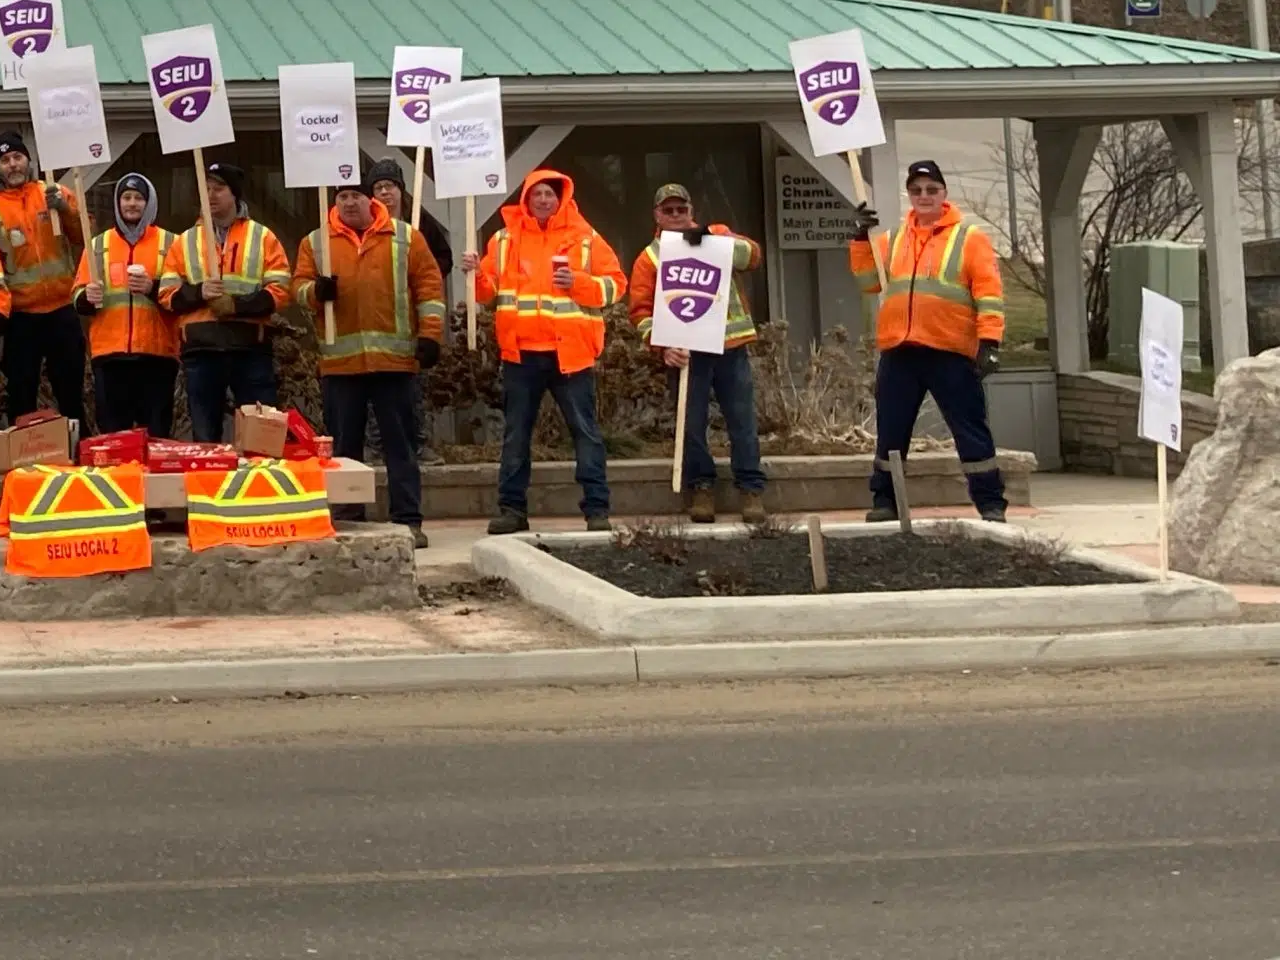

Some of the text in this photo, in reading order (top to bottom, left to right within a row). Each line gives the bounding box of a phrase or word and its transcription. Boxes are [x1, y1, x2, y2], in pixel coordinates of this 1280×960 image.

[5, 7, 48, 26] SEIU
[23, 37, 37, 54] 2
[160, 63, 204, 86] SEIU
[807, 67, 852, 91] SEIU
[181, 96, 197, 116] 2
[414, 102, 428, 118] 2
[830, 100, 846, 120] 2
[301, 114, 338, 125] Locked
[310, 132, 330, 142] Out
[782, 219, 813, 228] Main
[784, 232, 800, 241] on
[666, 266, 715, 286] SEIU
[680, 297, 696, 317] 2
[226, 524, 297, 539] SEIU LOCAL 2
[47, 538, 119, 560] SEIU LOCAL 2
